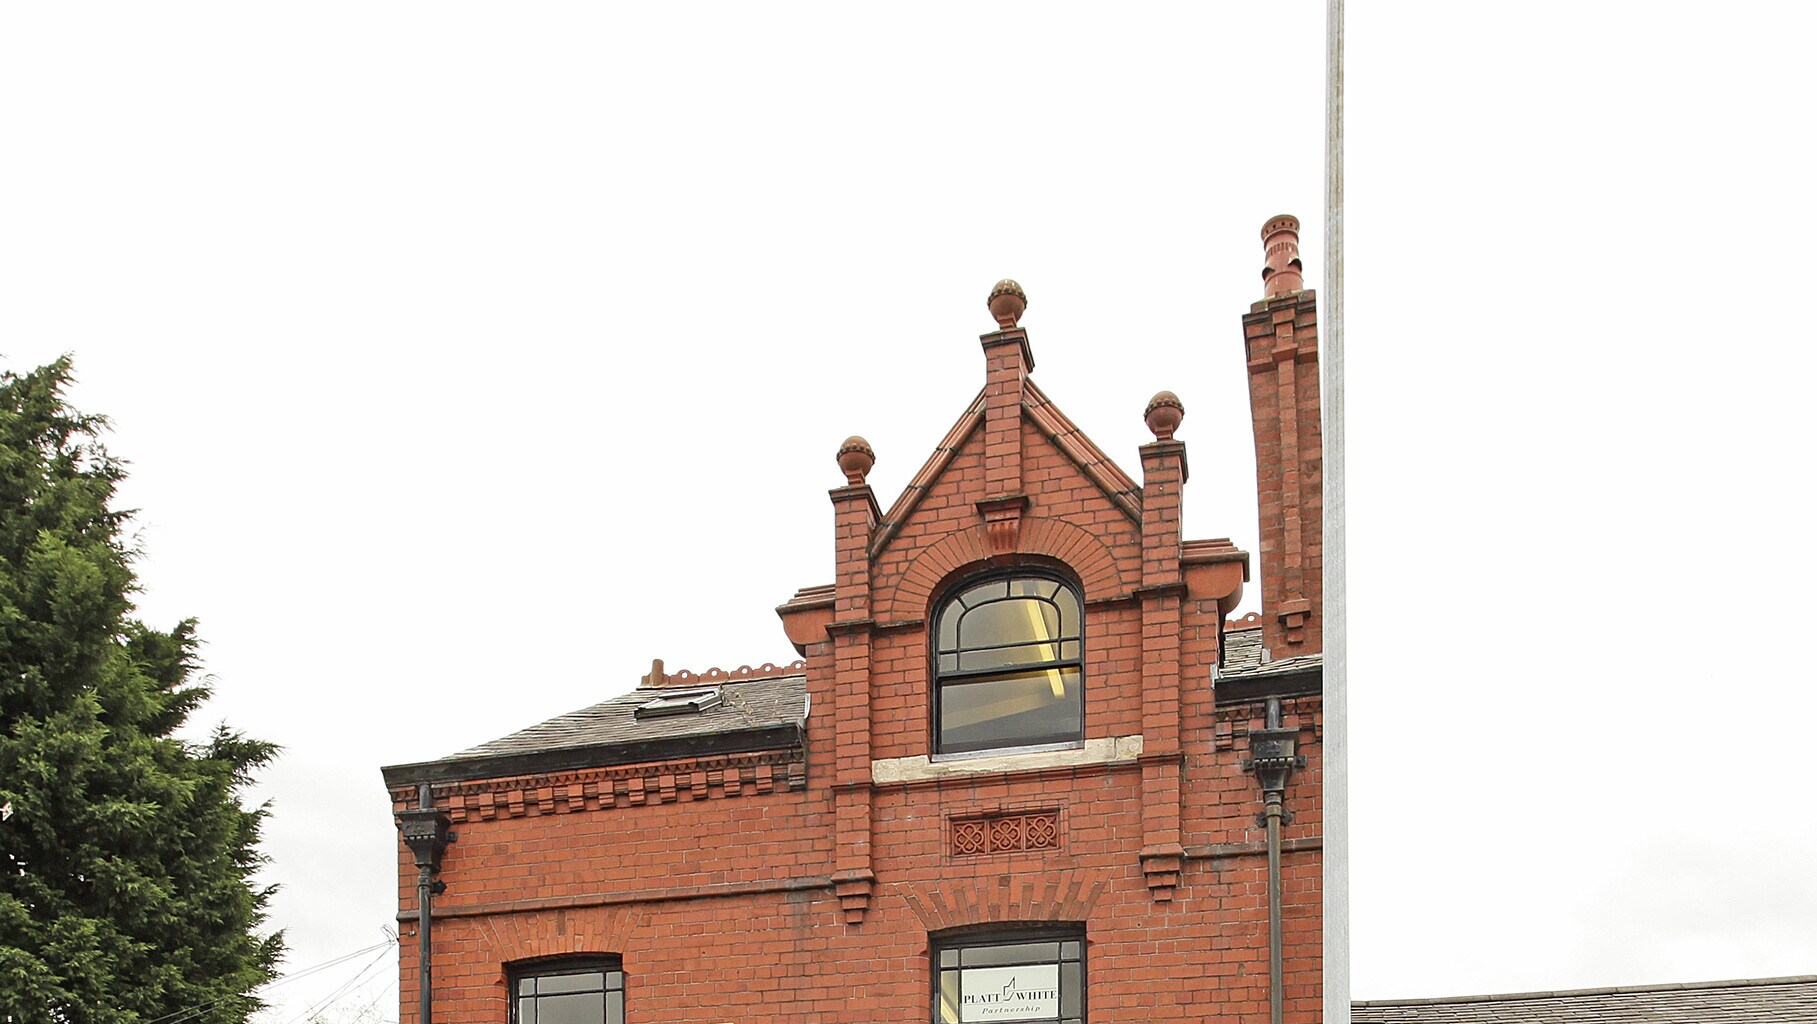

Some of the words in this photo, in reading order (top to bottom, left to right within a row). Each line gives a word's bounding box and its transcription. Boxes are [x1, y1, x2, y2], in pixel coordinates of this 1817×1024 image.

[964, 993, 1001, 1004] PLATT
[1015, 990, 1057, 1001] WHITE
[981, 1005, 1041, 1015] Partnership
